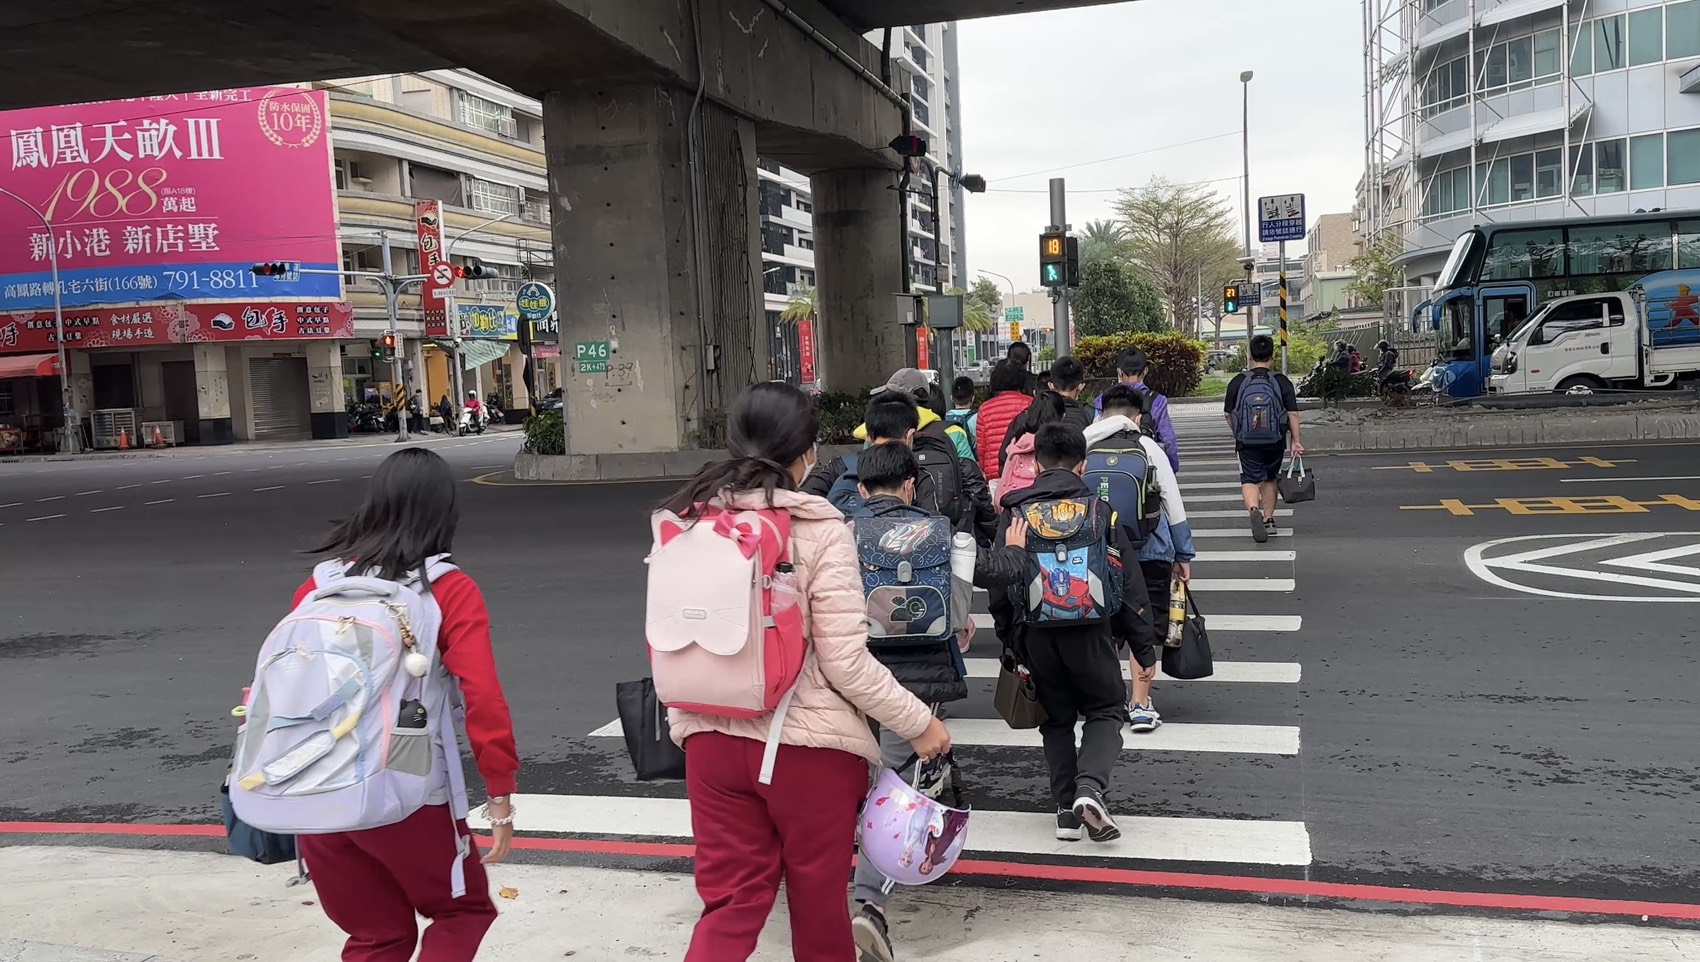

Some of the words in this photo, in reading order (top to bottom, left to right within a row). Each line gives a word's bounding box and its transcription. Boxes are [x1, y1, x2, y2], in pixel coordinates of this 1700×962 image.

[269, 101, 310, 113] 防水保固
[271, 112, 312, 132] 10年
[41, 167, 167, 222] 1988
[161, 197, 197, 213] 萬起
[29, 228, 110, 261] 新小港
[122, 222, 220, 255] 新店墅
[1048, 239, 1059, 254] 18
[163, 270, 258, 290] 791-8811
[296, 305, 330, 314] 創意包子
[520, 297, 548, 310] 娃娃機
[65, 317, 100, 327] 中式早點
[109, 312, 153, 326] 食材嚴選
[297, 316, 330, 324] 中式早點
[471, 310, 497, 331] 加勒比
[48, 331, 82, 342] 古豆漿
[576, 343, 607, 359] P46
